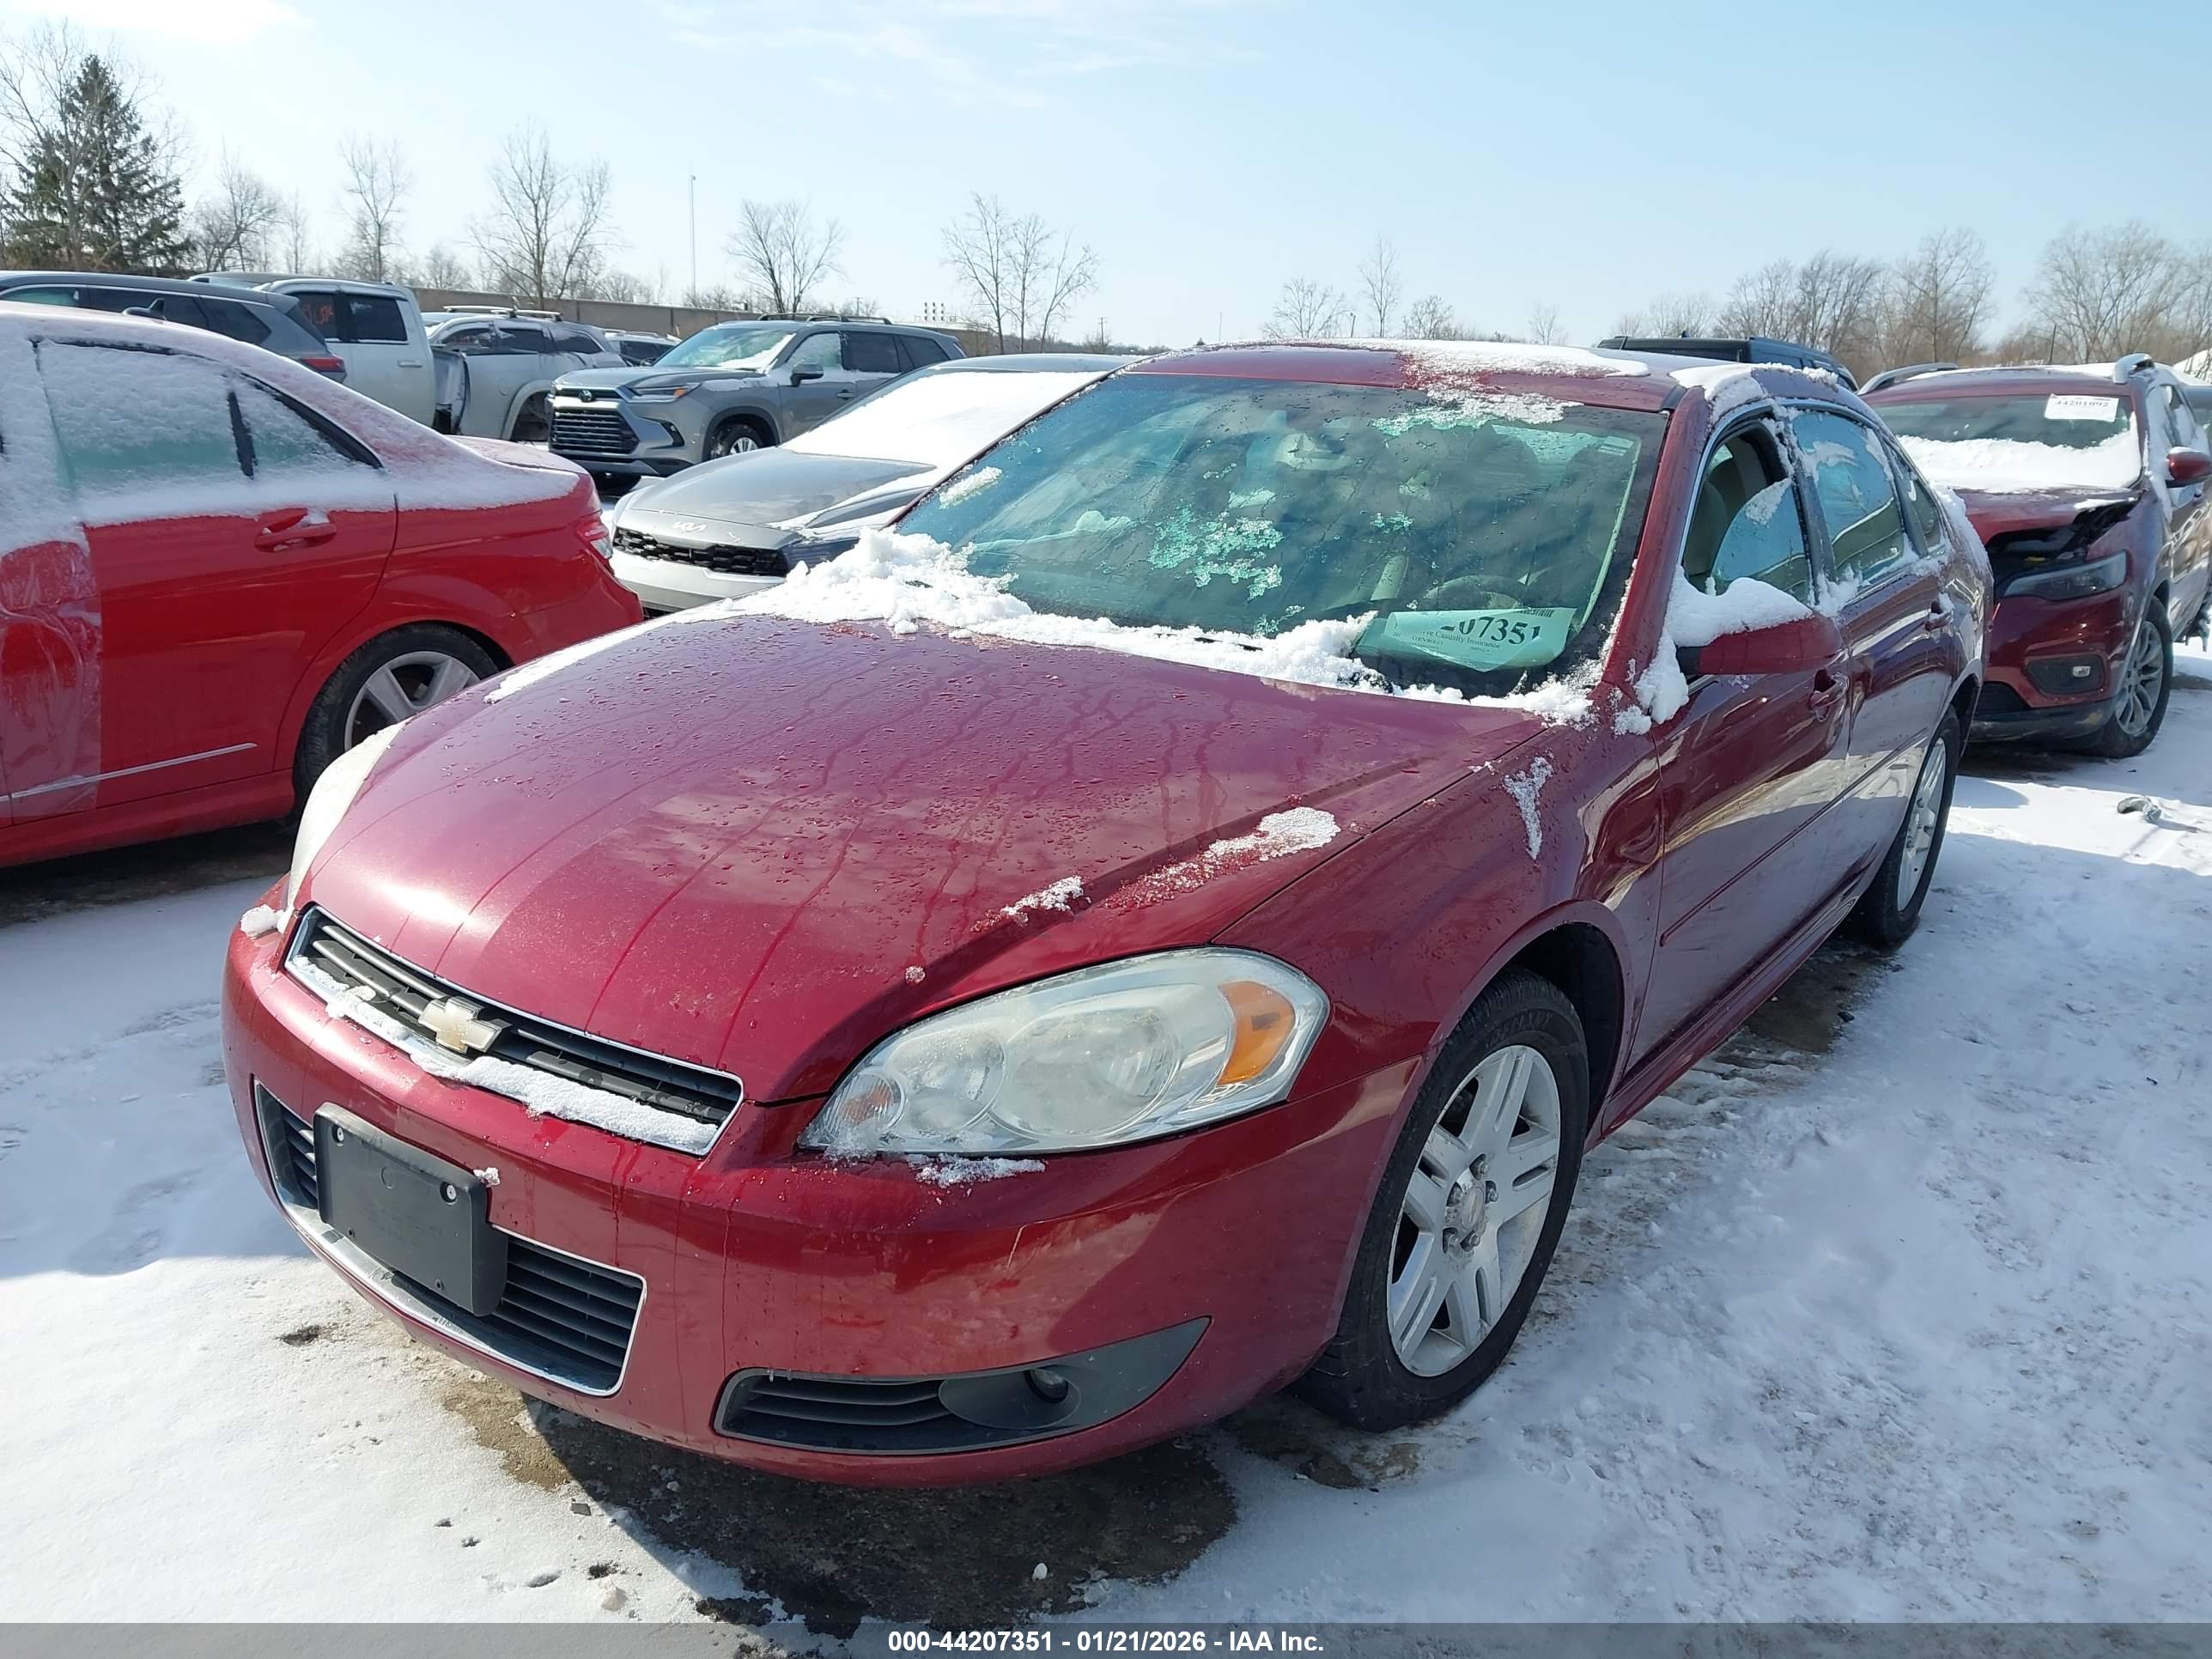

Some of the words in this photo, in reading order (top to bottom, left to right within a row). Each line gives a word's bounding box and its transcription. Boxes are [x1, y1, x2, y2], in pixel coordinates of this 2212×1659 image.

[1435, 629, 1464, 643] Casualty
[1467, 636, 1501, 649] Insurance
[1440, 616, 1541, 645] 07351
